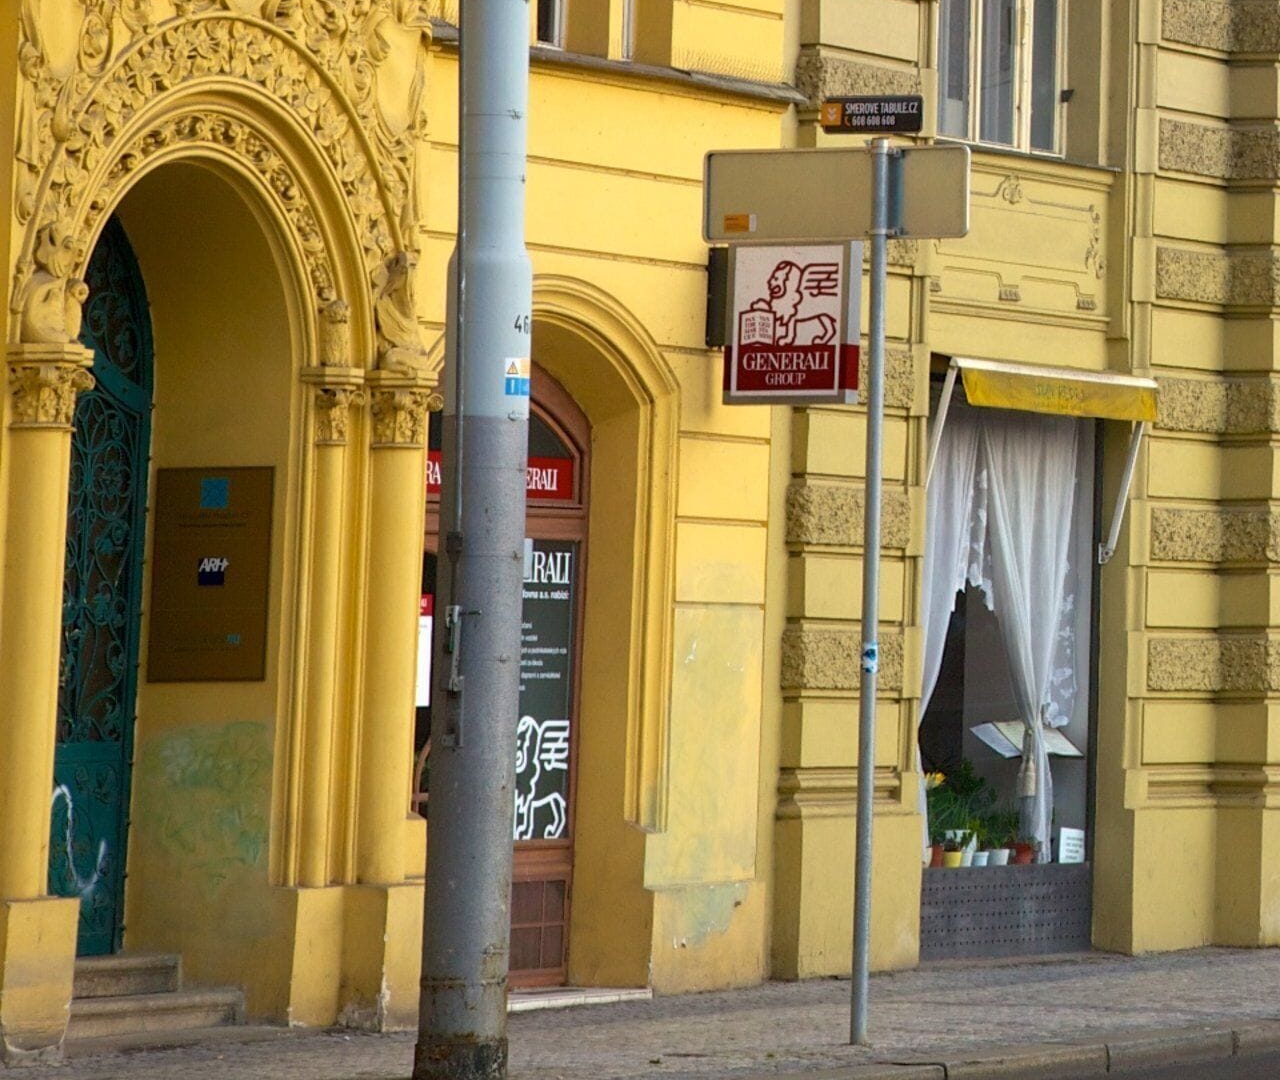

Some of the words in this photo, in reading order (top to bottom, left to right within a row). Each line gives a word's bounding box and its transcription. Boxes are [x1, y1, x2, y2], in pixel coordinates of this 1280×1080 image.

[851, 115, 865, 126] 608
[866, 115, 880, 126] 608
[881, 115, 895, 126] 608
[743, 351, 829, 371] GENERALI
[765, 372, 806, 386] GROUP
